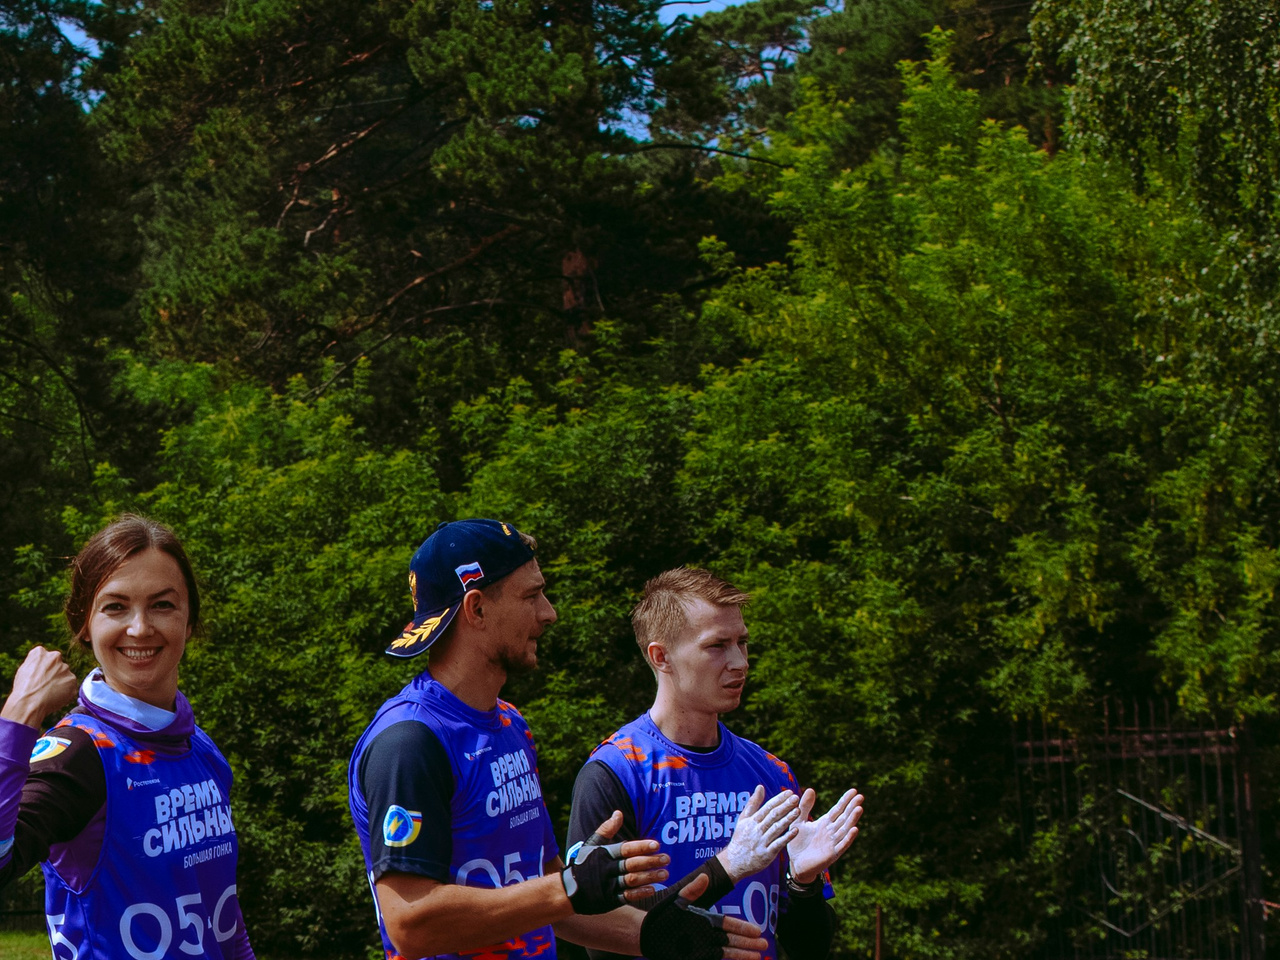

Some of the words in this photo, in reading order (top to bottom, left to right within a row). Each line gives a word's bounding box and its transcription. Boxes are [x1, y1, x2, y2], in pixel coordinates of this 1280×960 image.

[489, 748, 531, 788] ВРЕМЯ
[154, 779, 222, 825] ВРЕМЯ
[675, 791, 752, 819] ВРЕМЯ
[143, 804, 236, 858] СИЛЬНЫ
[661, 813, 741, 845] СИЛЬН
[183, 847, 213, 869] БОЛЬШАЯ
[212, 841, 233, 859] ГОНКА
